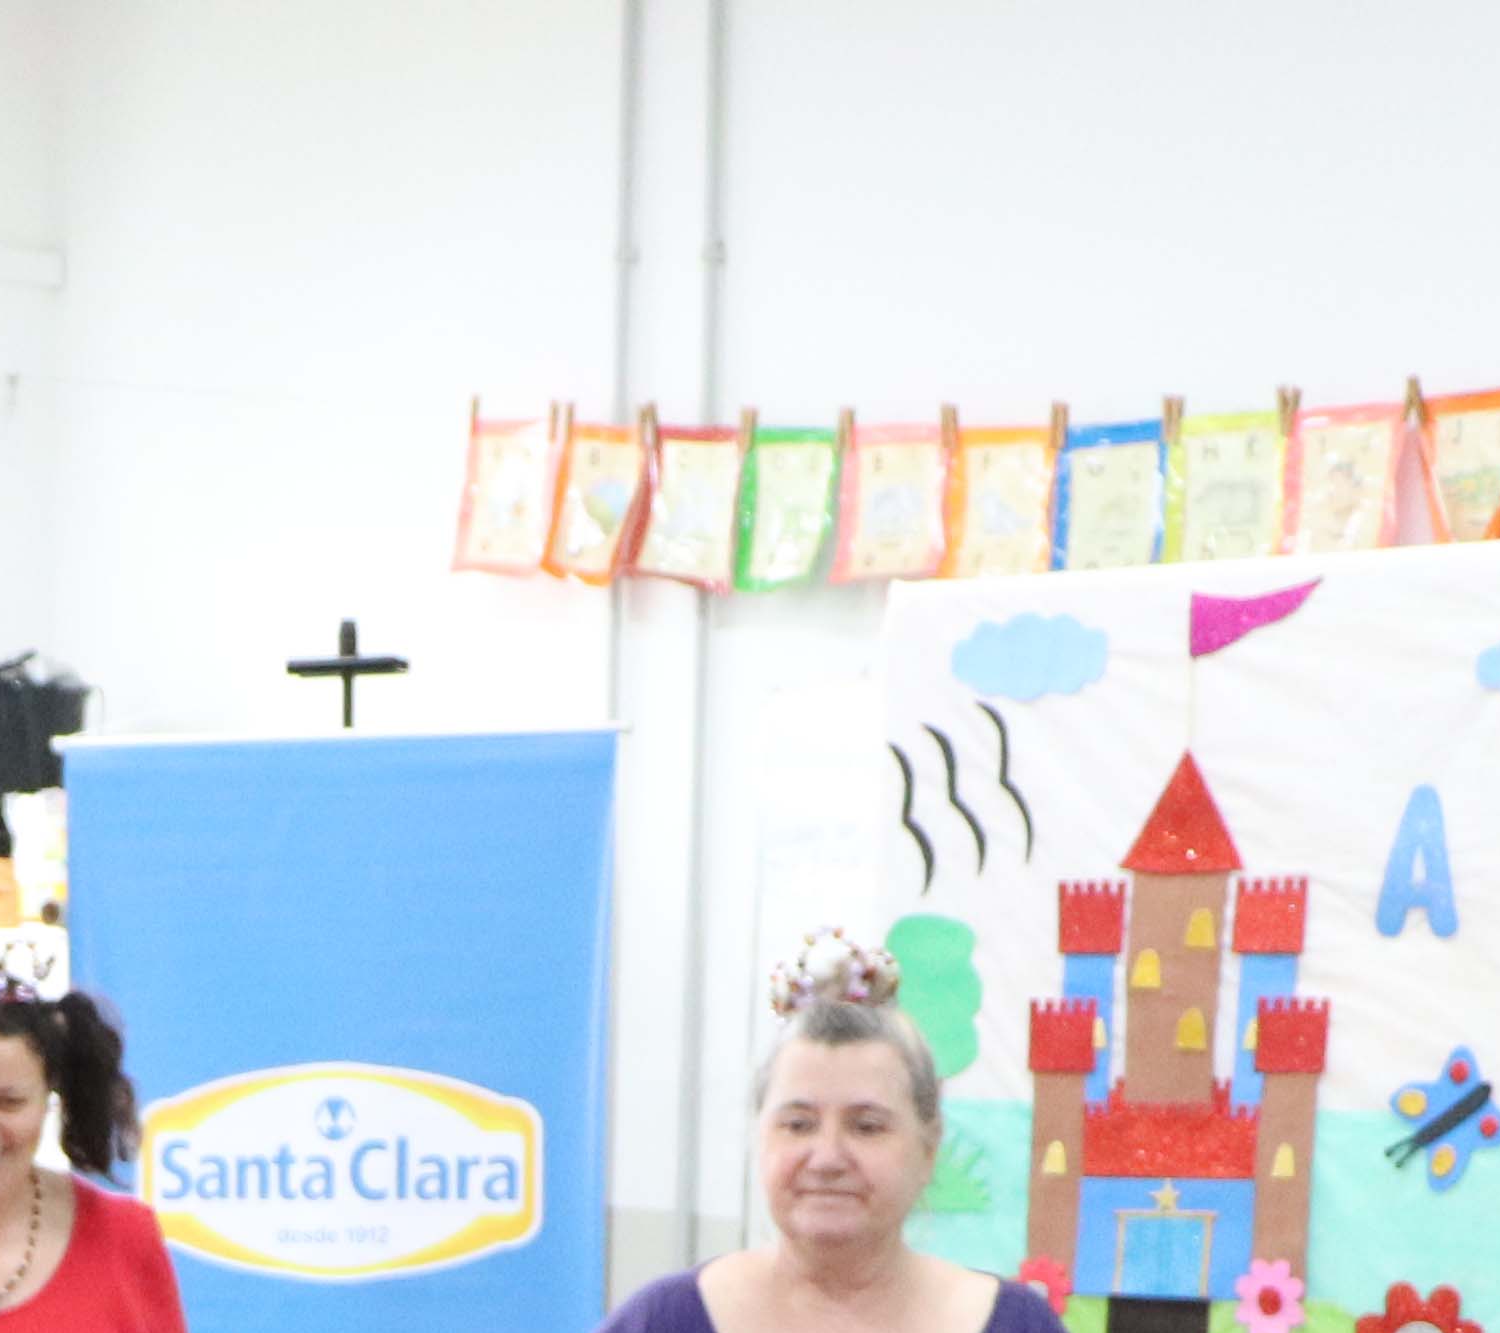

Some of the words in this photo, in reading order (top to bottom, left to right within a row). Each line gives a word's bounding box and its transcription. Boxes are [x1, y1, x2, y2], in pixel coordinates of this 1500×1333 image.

[1375, 784, 1458, 938] A
[161, 1139, 336, 1201] Santa
[349, 1135, 519, 1202] Clara
